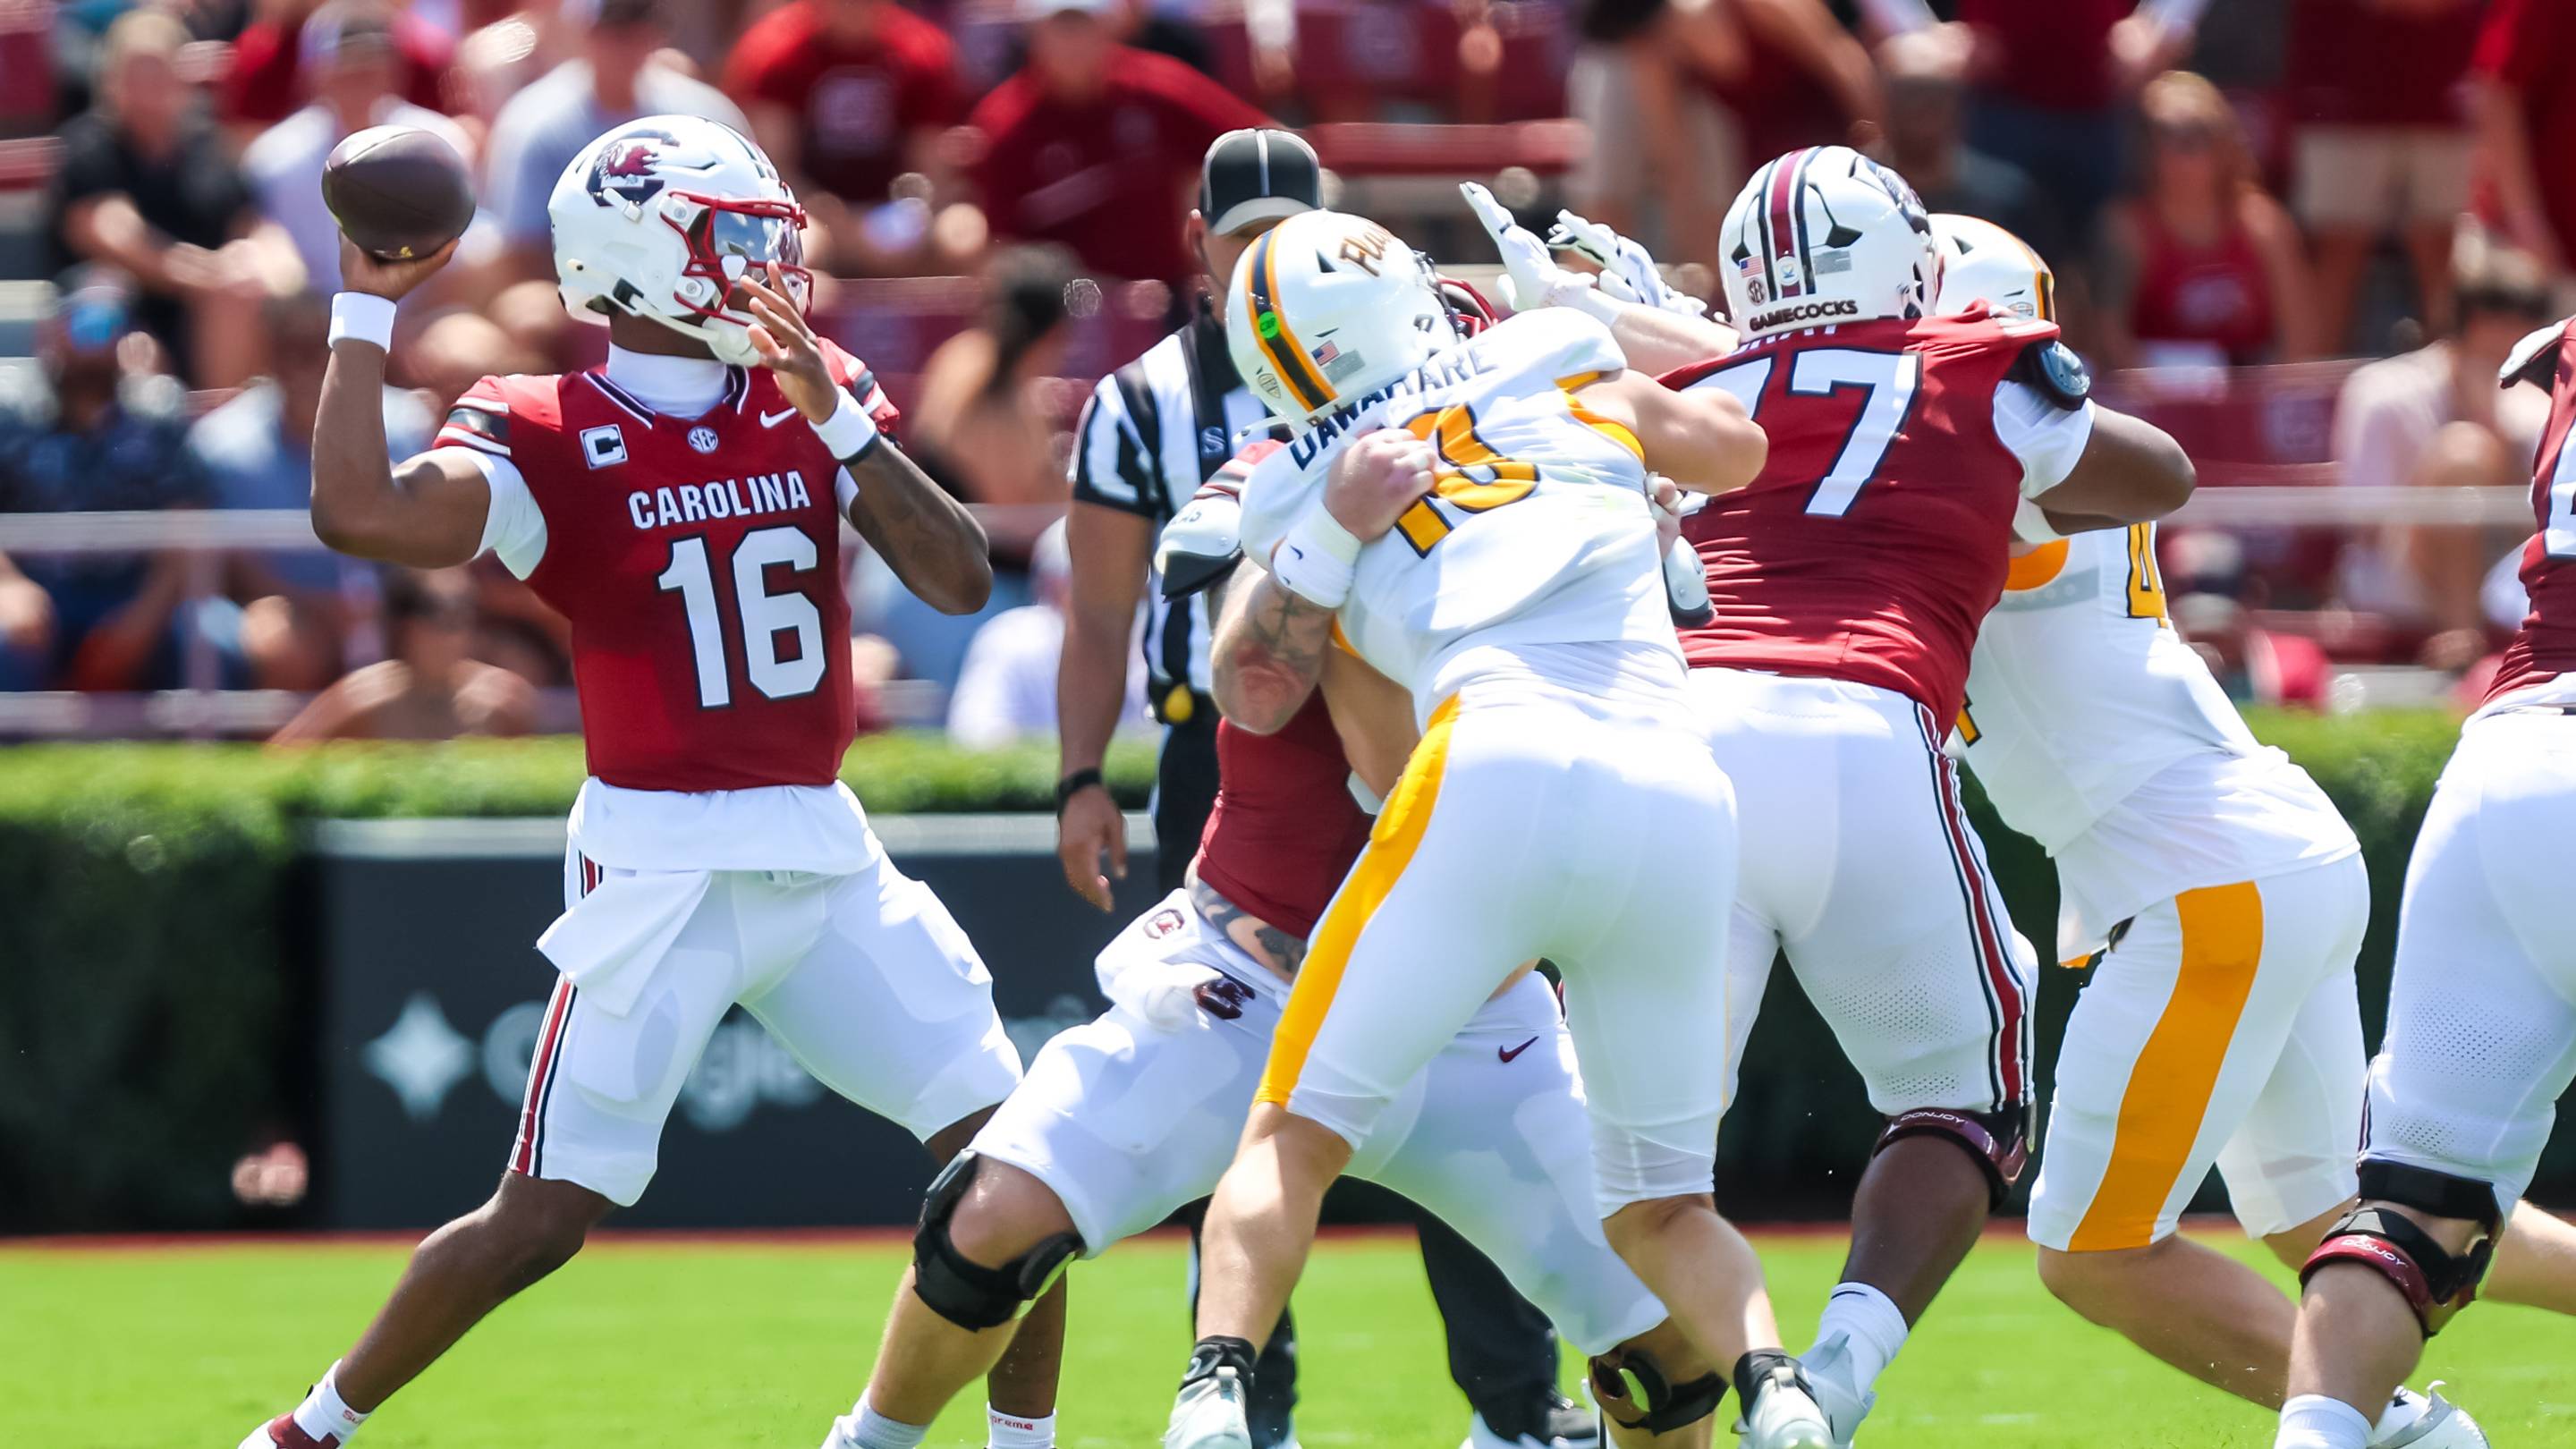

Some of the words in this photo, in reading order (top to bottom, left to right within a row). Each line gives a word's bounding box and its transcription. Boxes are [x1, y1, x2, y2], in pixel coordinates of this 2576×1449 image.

[1750, 300, 1858, 331] GAMECOCKS
[583, 427, 625, 466] C
[688, 426, 718, 453] SEC
[628, 470, 811, 530] CAROLINA
[657, 524, 827, 708] 16
[1900, 1112, 1965, 1123] DONJOY
[2341, 1239, 2406, 1266] DONJOY
